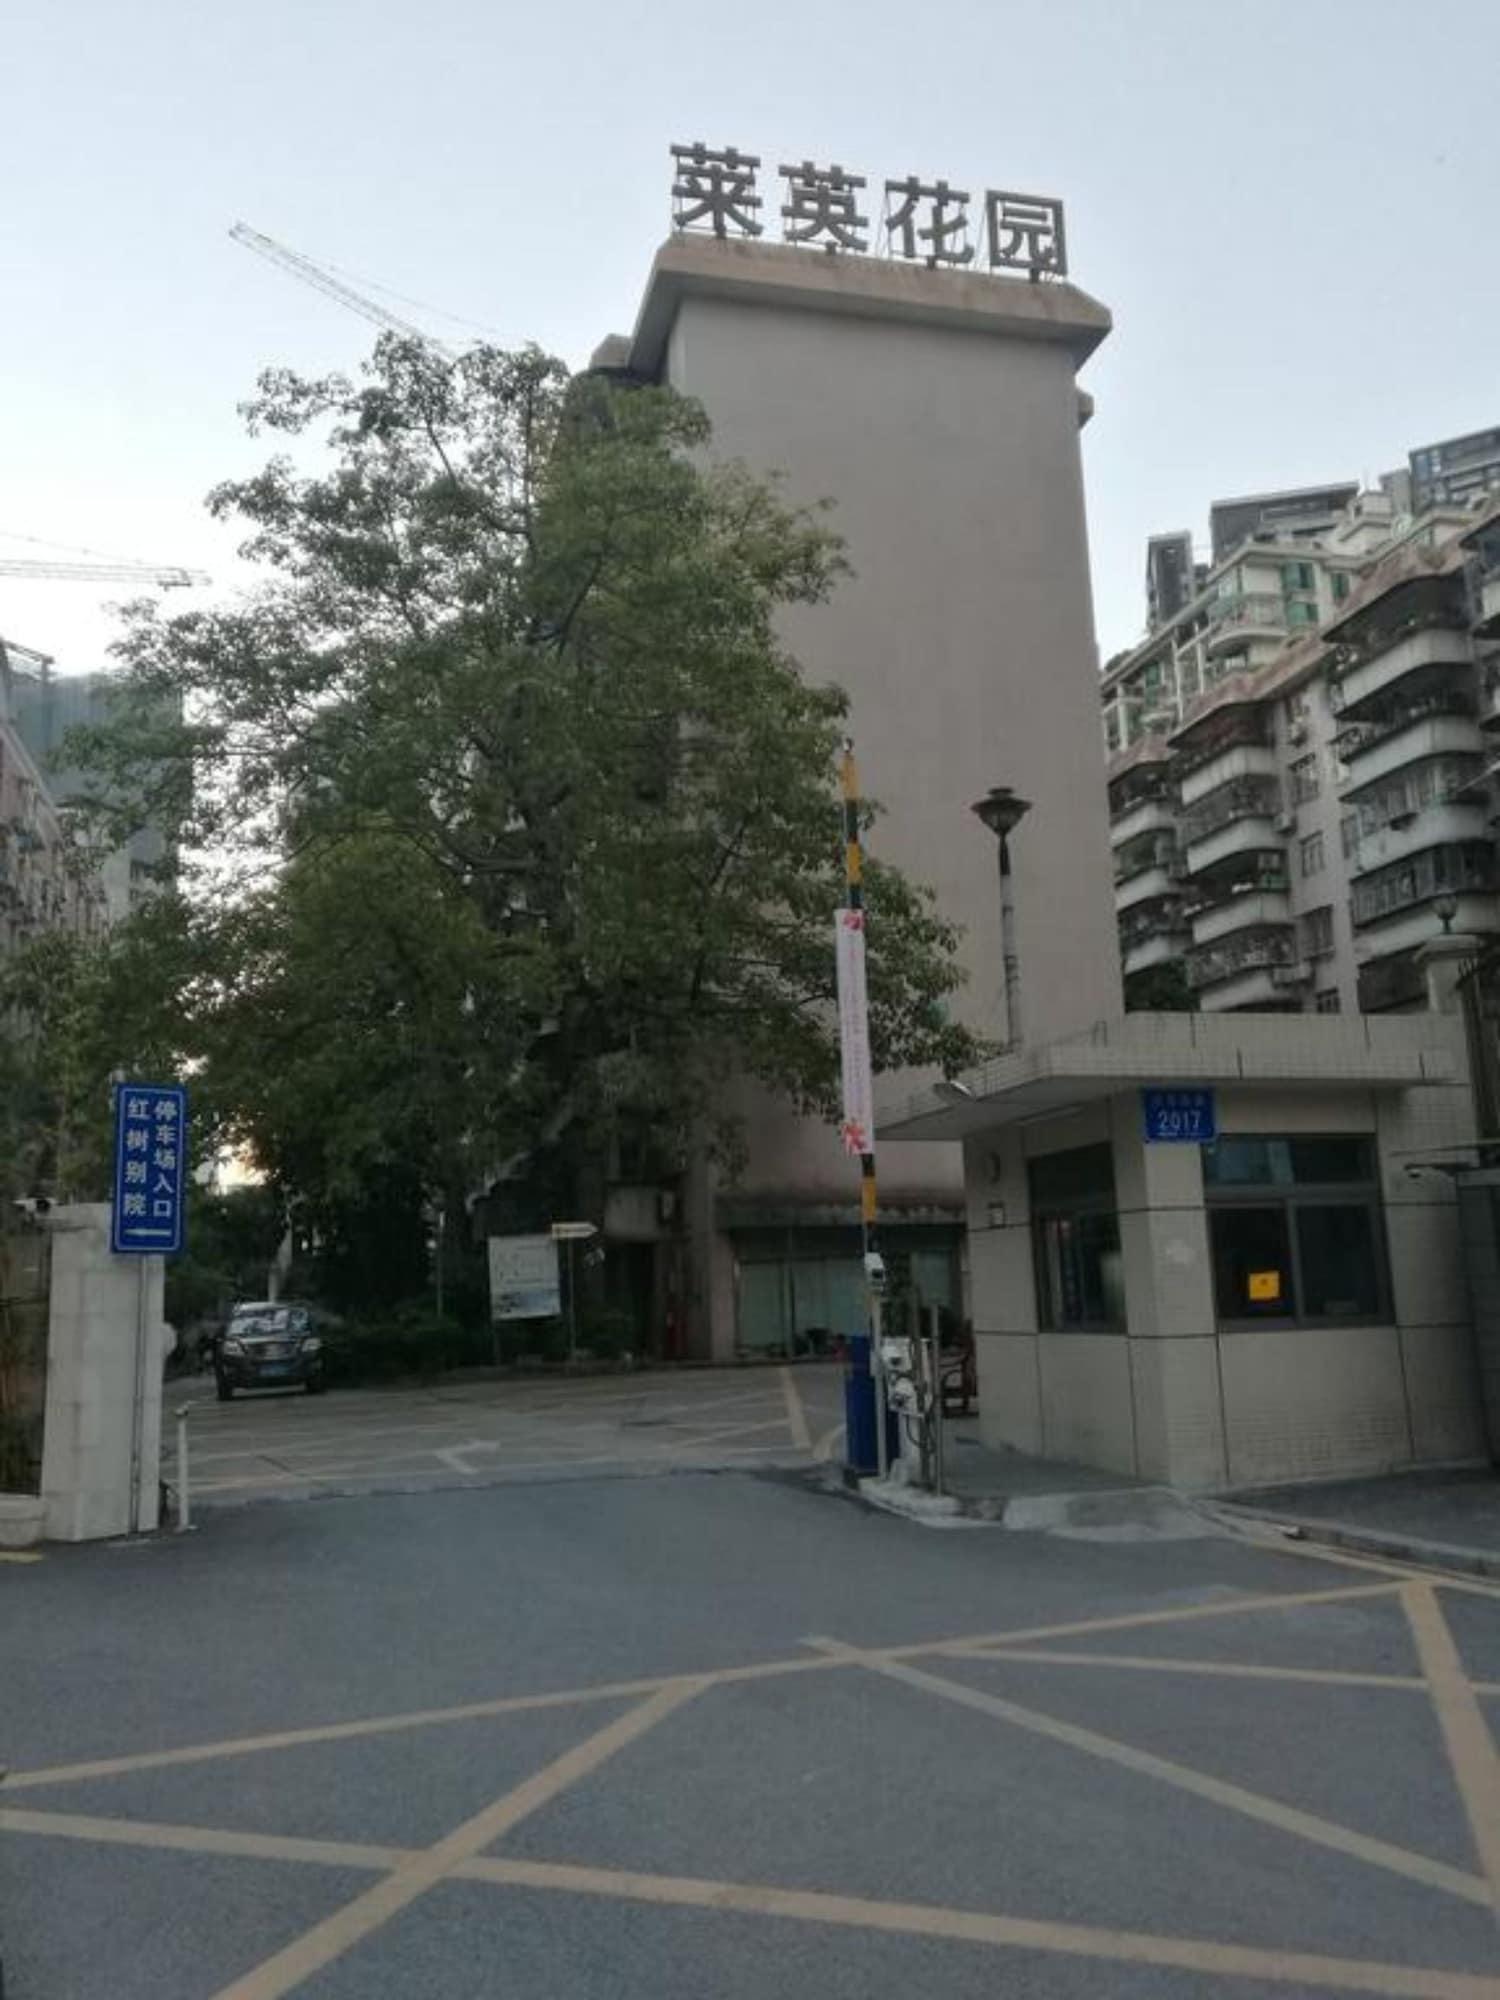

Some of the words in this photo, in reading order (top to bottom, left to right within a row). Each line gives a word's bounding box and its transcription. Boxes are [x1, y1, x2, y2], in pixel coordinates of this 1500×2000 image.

[669, 142, 1068, 277] 莱英花园
[123, 1096, 150, 1217] 红树别院
[153, 1100, 178, 1218] 停车场入口
[1157, 1110, 1202, 1130] 2017
